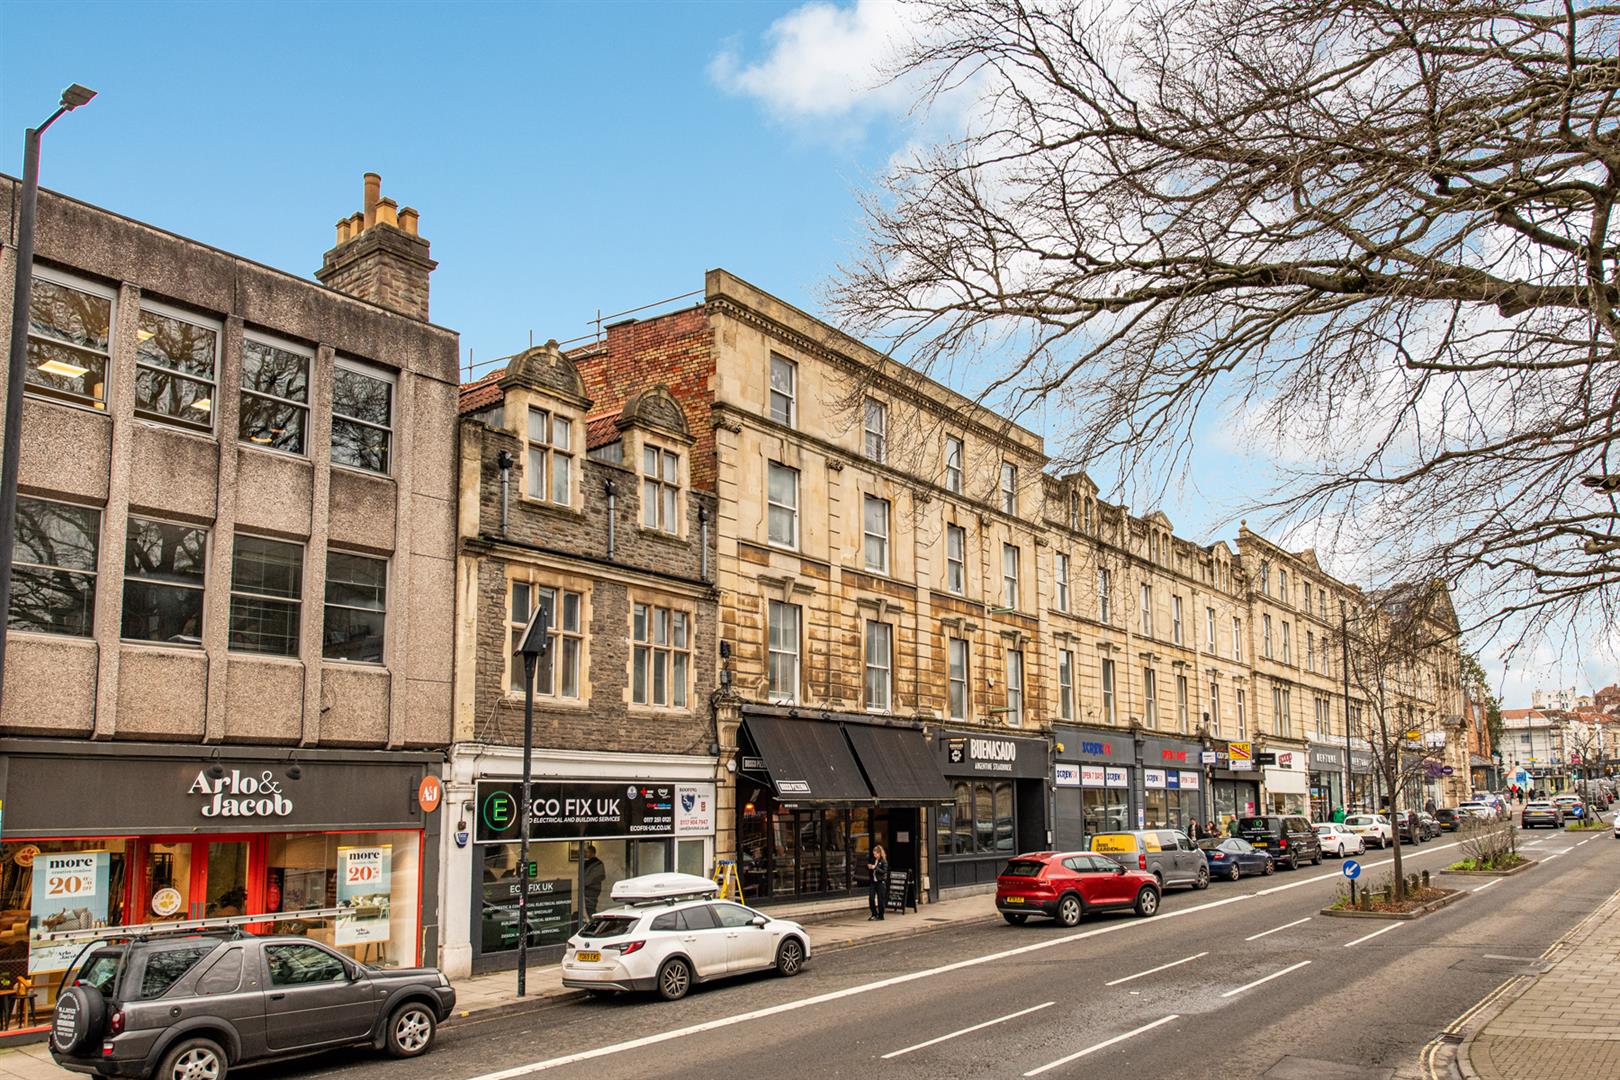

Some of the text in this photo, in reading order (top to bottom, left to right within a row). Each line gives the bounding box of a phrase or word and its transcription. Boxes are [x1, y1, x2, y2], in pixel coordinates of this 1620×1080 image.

[970, 739, 1016, 761] BUENASADO
[1316, 753, 1336, 763] NEPTUNE
[187, 770, 282, 794] Arlo&
[1057, 770, 1077, 779] SCREWFIX
[201, 793, 293, 817] Jacob
[565, 799, 592, 816] FIX
[597, 798, 620, 815] UK
[349, 851, 380, 860] more
[49, 858, 93, 869] more
[349, 866, 372, 881] 20
[49, 876, 82, 895] 20
[510, 882, 554, 893] EC FIX UK
